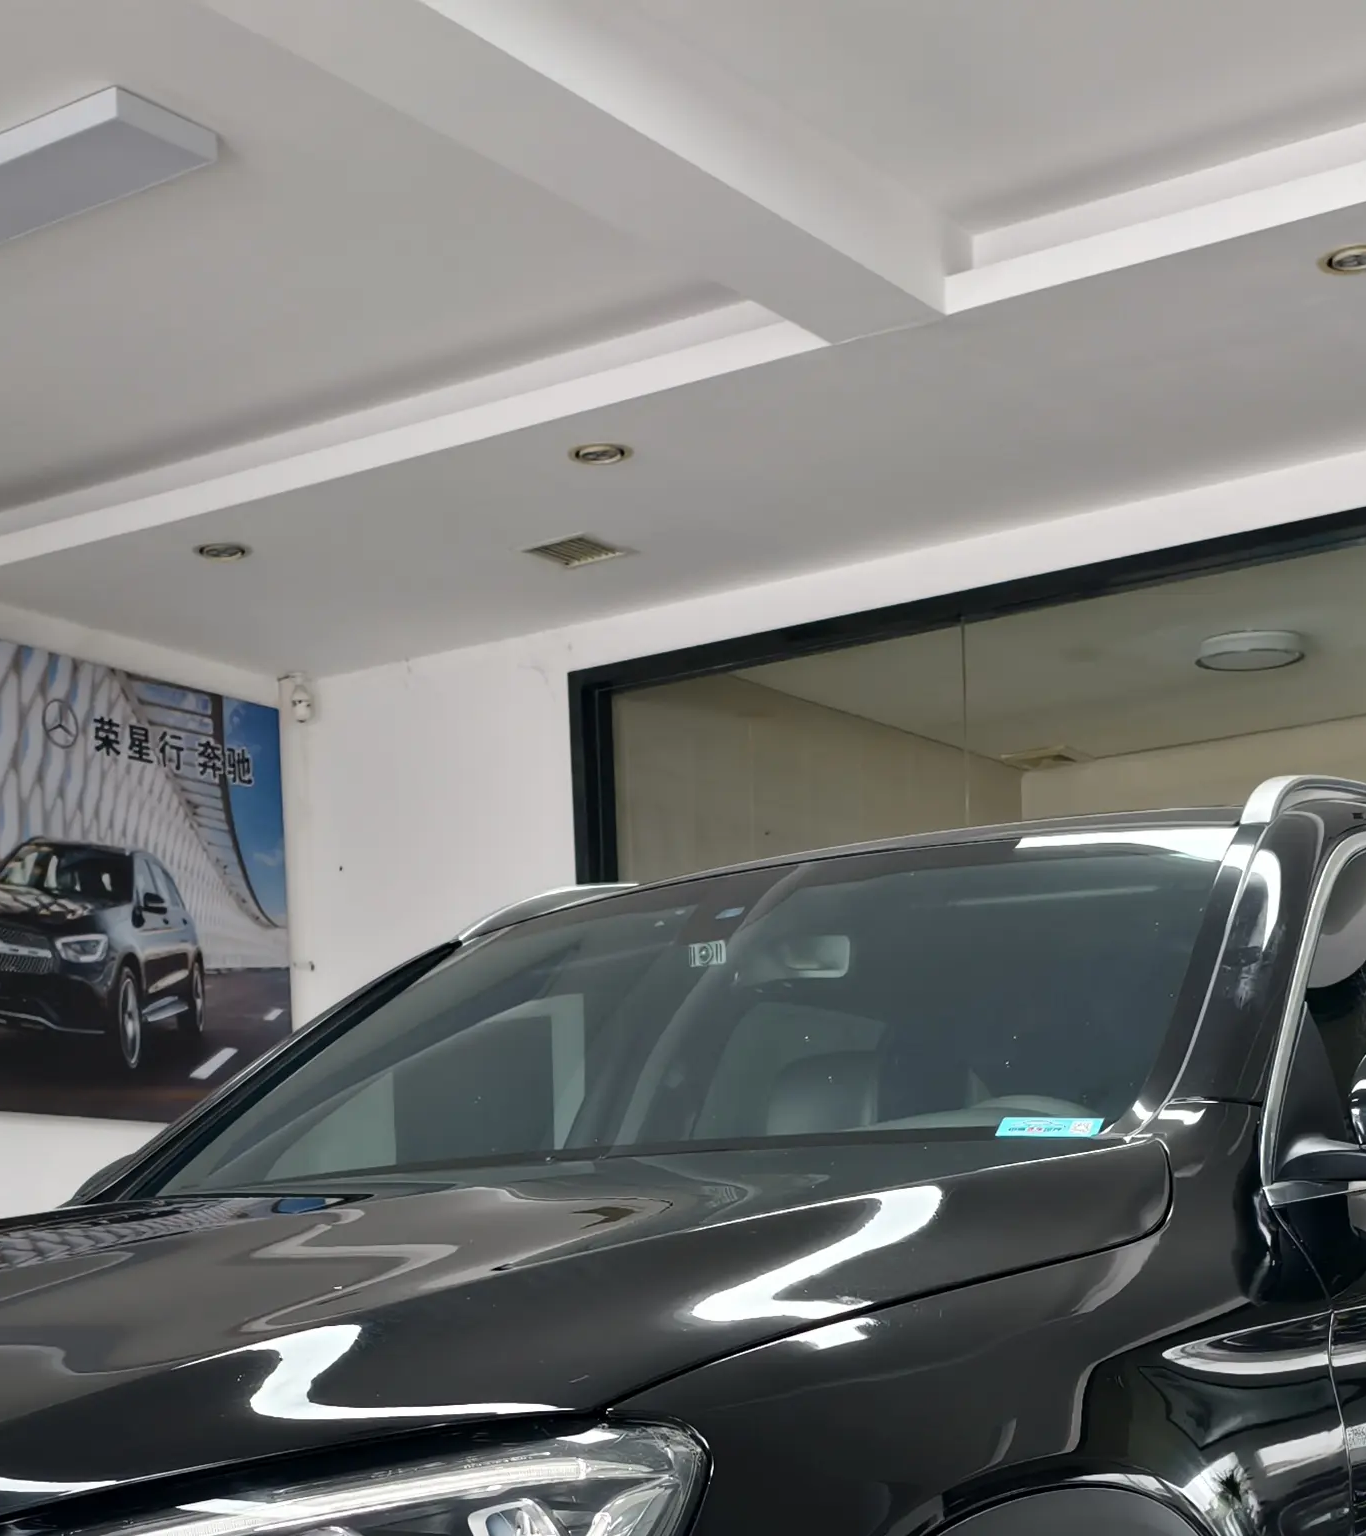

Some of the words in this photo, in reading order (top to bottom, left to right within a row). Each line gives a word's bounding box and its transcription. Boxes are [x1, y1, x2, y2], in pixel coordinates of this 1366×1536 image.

[93, 715, 184, 771] 荣星行
[197, 739, 253, 785] 奔驰
